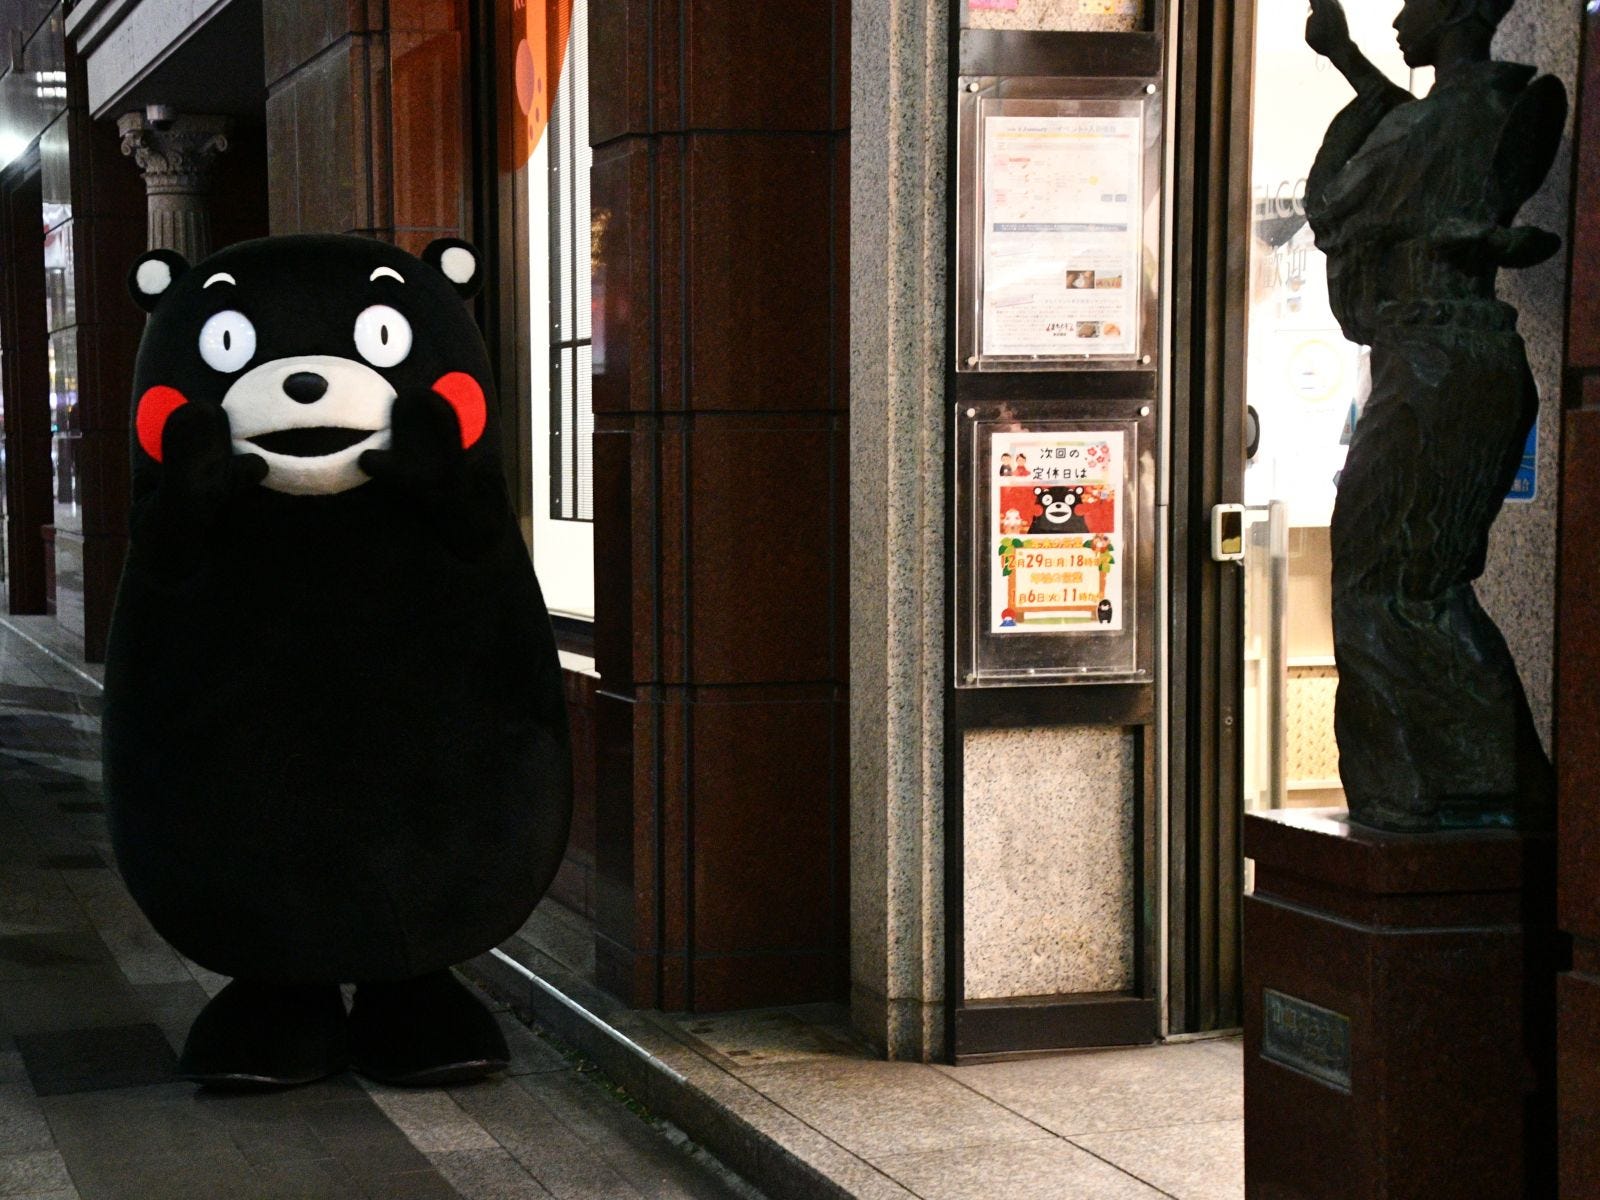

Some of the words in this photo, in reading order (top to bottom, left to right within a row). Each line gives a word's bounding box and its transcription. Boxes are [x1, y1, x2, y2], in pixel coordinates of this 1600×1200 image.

[1040, 447, 1080, 459] 次回の
[1032, 466, 1088, 480] 定休日は
